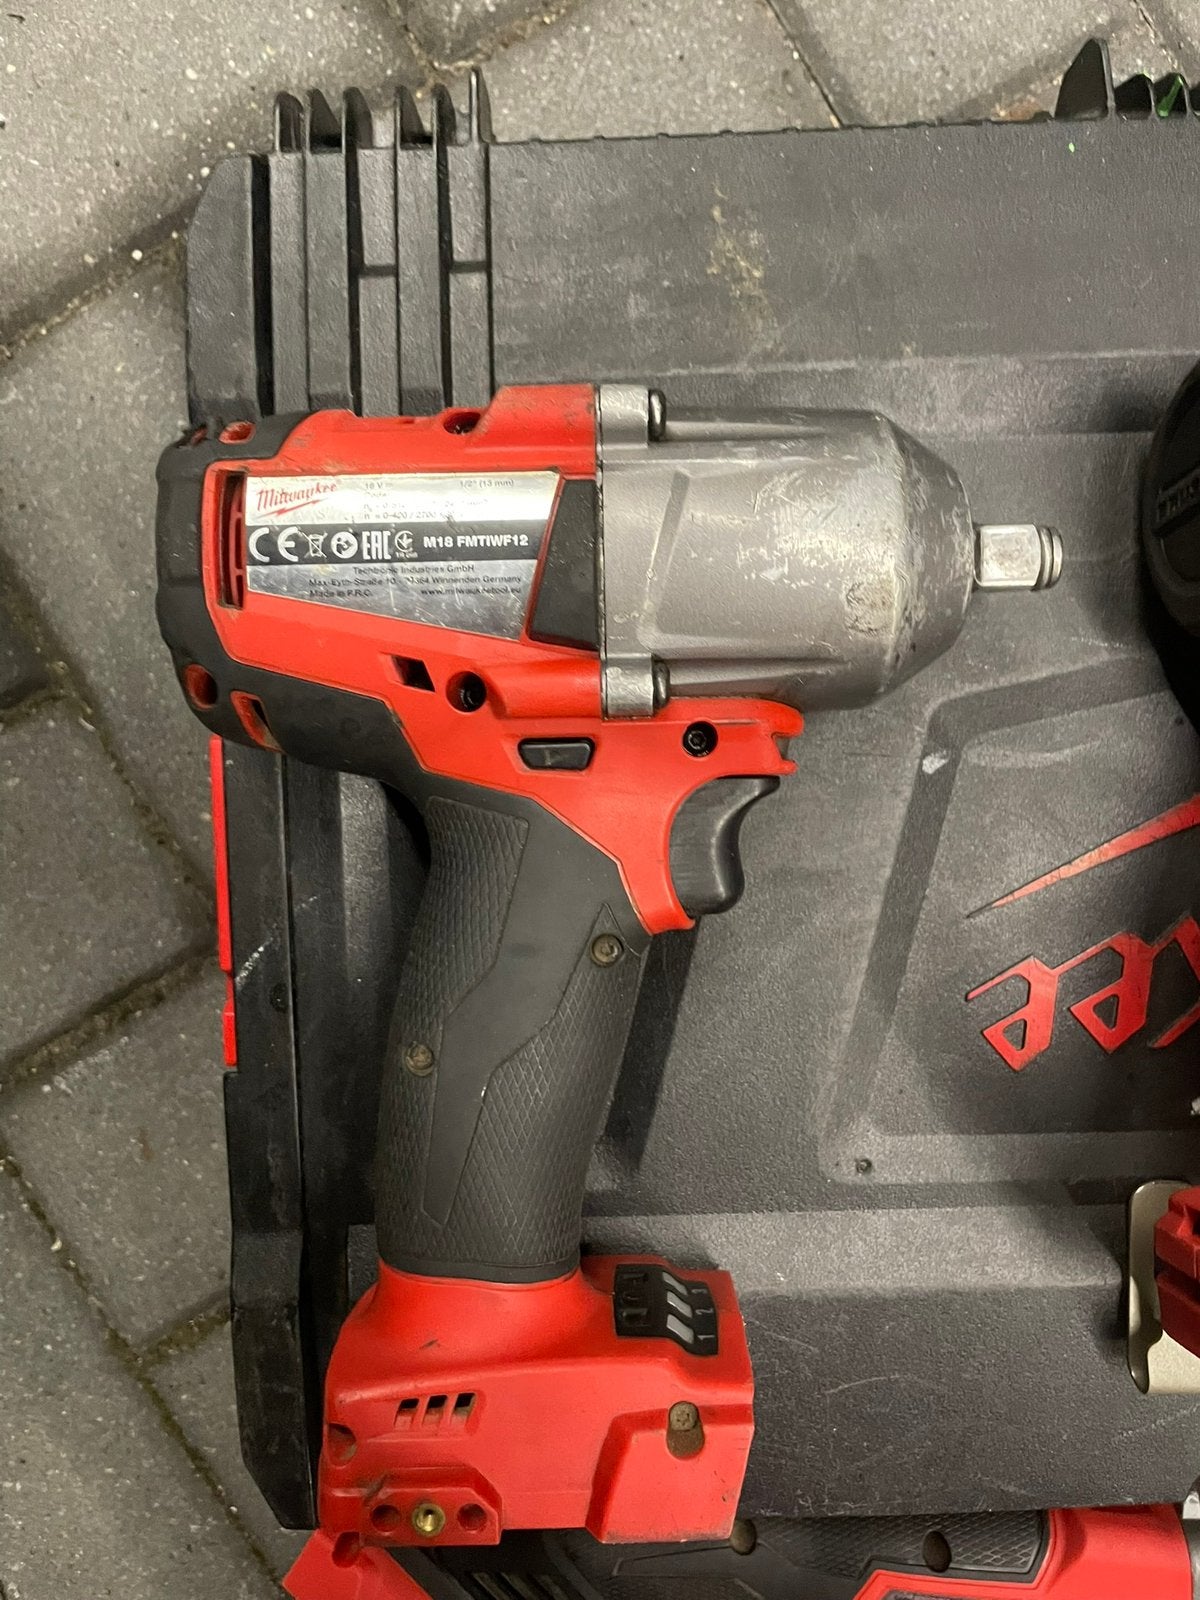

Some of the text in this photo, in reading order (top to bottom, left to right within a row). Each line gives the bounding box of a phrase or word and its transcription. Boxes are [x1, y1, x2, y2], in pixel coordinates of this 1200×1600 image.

[256, 481, 337, 511] Milwaukee
[424, 534, 530, 549] M18 FMTIWF12
[401, 565, 444, 574] Industries
[447, 564, 475, 574] GmbH
[432, 575, 481, 584] Winnenden
[482, 575, 522, 584] Germany
[309, 589, 335, 598] Made
